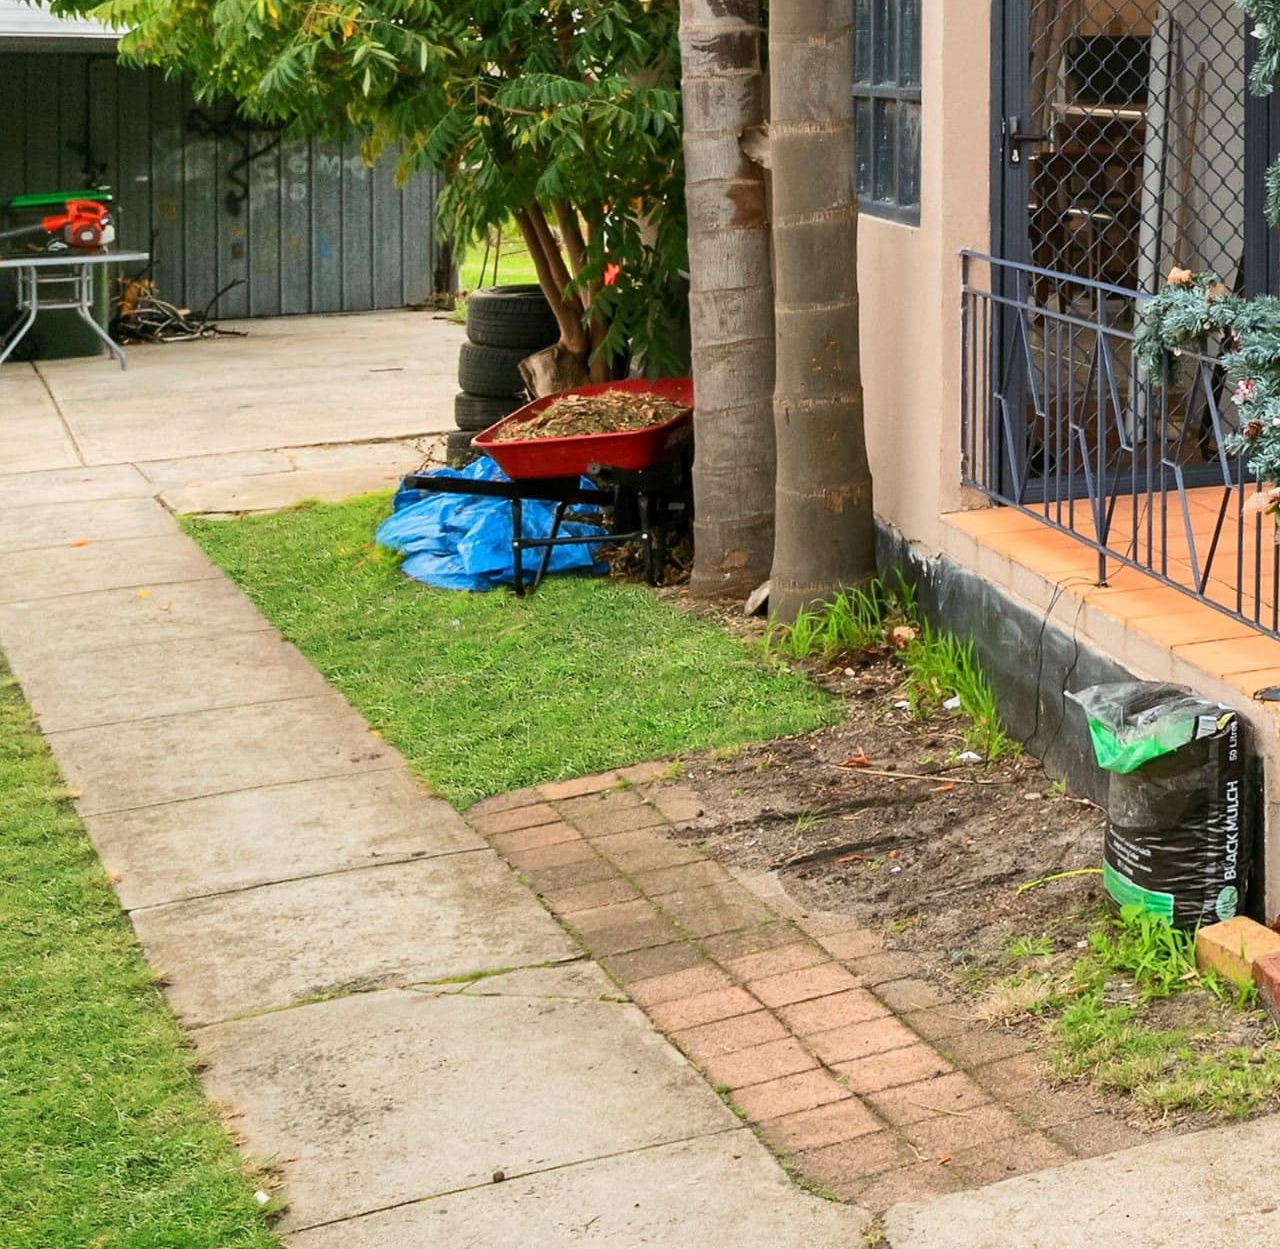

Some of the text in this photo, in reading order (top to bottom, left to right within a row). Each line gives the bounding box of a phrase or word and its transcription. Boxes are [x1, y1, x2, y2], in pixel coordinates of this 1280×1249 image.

[1229, 749, 1237, 762] 50
[1224, 780, 1239, 880] BLACK MULCH
